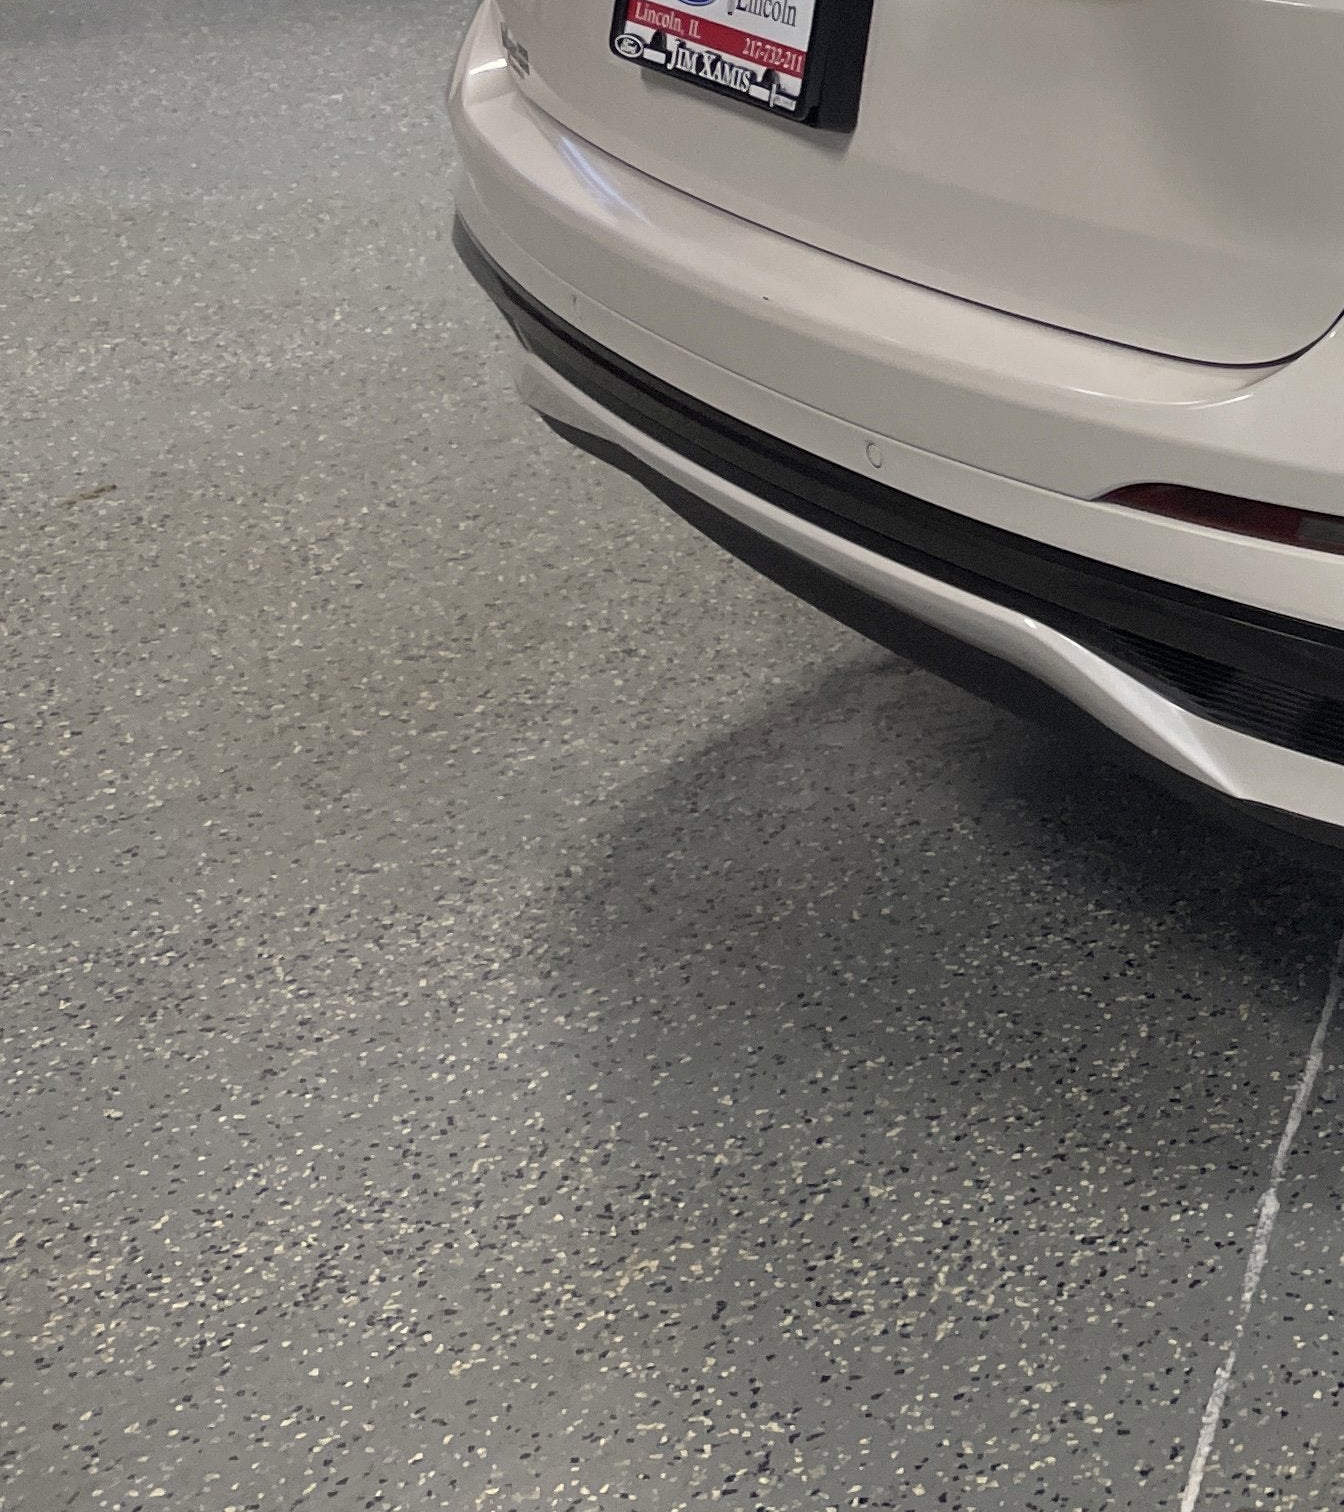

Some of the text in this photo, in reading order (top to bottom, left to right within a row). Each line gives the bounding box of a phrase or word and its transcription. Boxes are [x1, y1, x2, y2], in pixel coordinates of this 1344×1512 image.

[689, 19, 701, 39] IL
[667, 40, 697, 74] JIM
[699, 52, 750, 92] XAMIS
